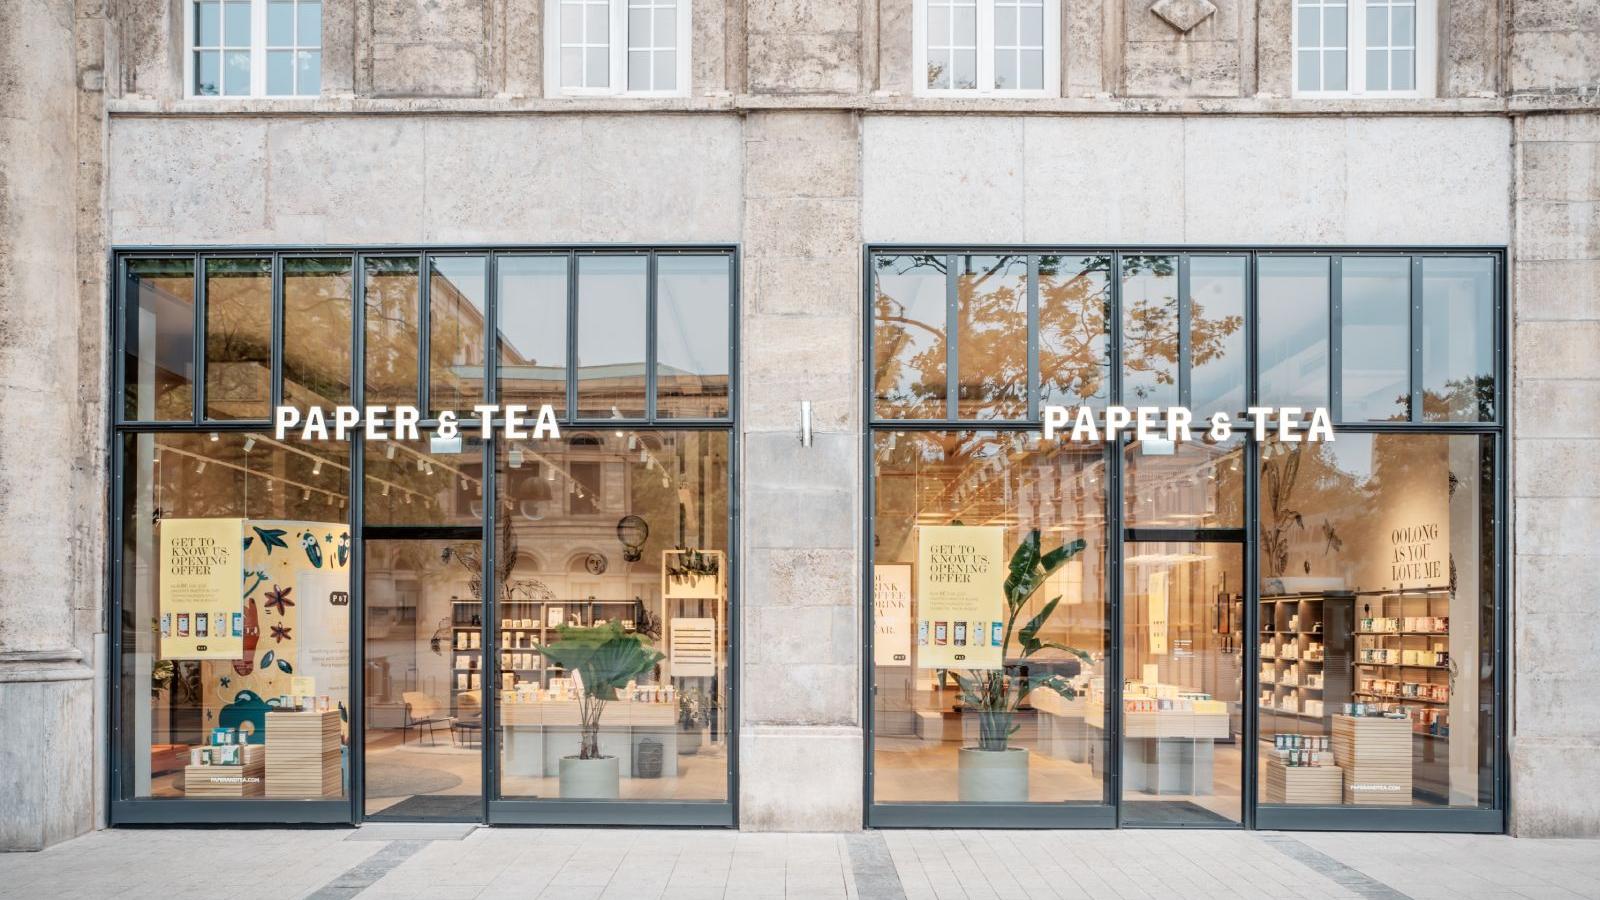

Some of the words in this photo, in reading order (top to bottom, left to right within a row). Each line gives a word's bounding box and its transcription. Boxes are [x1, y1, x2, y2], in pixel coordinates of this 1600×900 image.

[275, 405, 420, 440] PAPER
[437, 410, 459, 439] &
[474, 404, 561, 440] TEA
[1044, 406, 1192, 441] PAPER
[1210, 411, 1232, 441] &
[1248, 407, 1336, 442] TEA
[1391, 524, 1438, 545] OOLONG
[171, 537, 196, 547] GET
[198, 537, 215, 547] TO
[171, 546, 208, 556] KNOW
[930, 545, 955, 554] GET
[958, 545, 975, 554] TO
[1391, 546, 1405, 563] AS
[1408, 544, 1431, 561] YOU
[171, 556, 227, 566] OPENING
[931, 554, 967, 564] KNOW
[171, 566, 211, 575] OFFER
[930, 564, 987, 574] OPENING
[1392, 563, 1421, 581] LOVE
[1424, 561, 1440, 578] ME
[930, 573, 971, 583] OFFER
